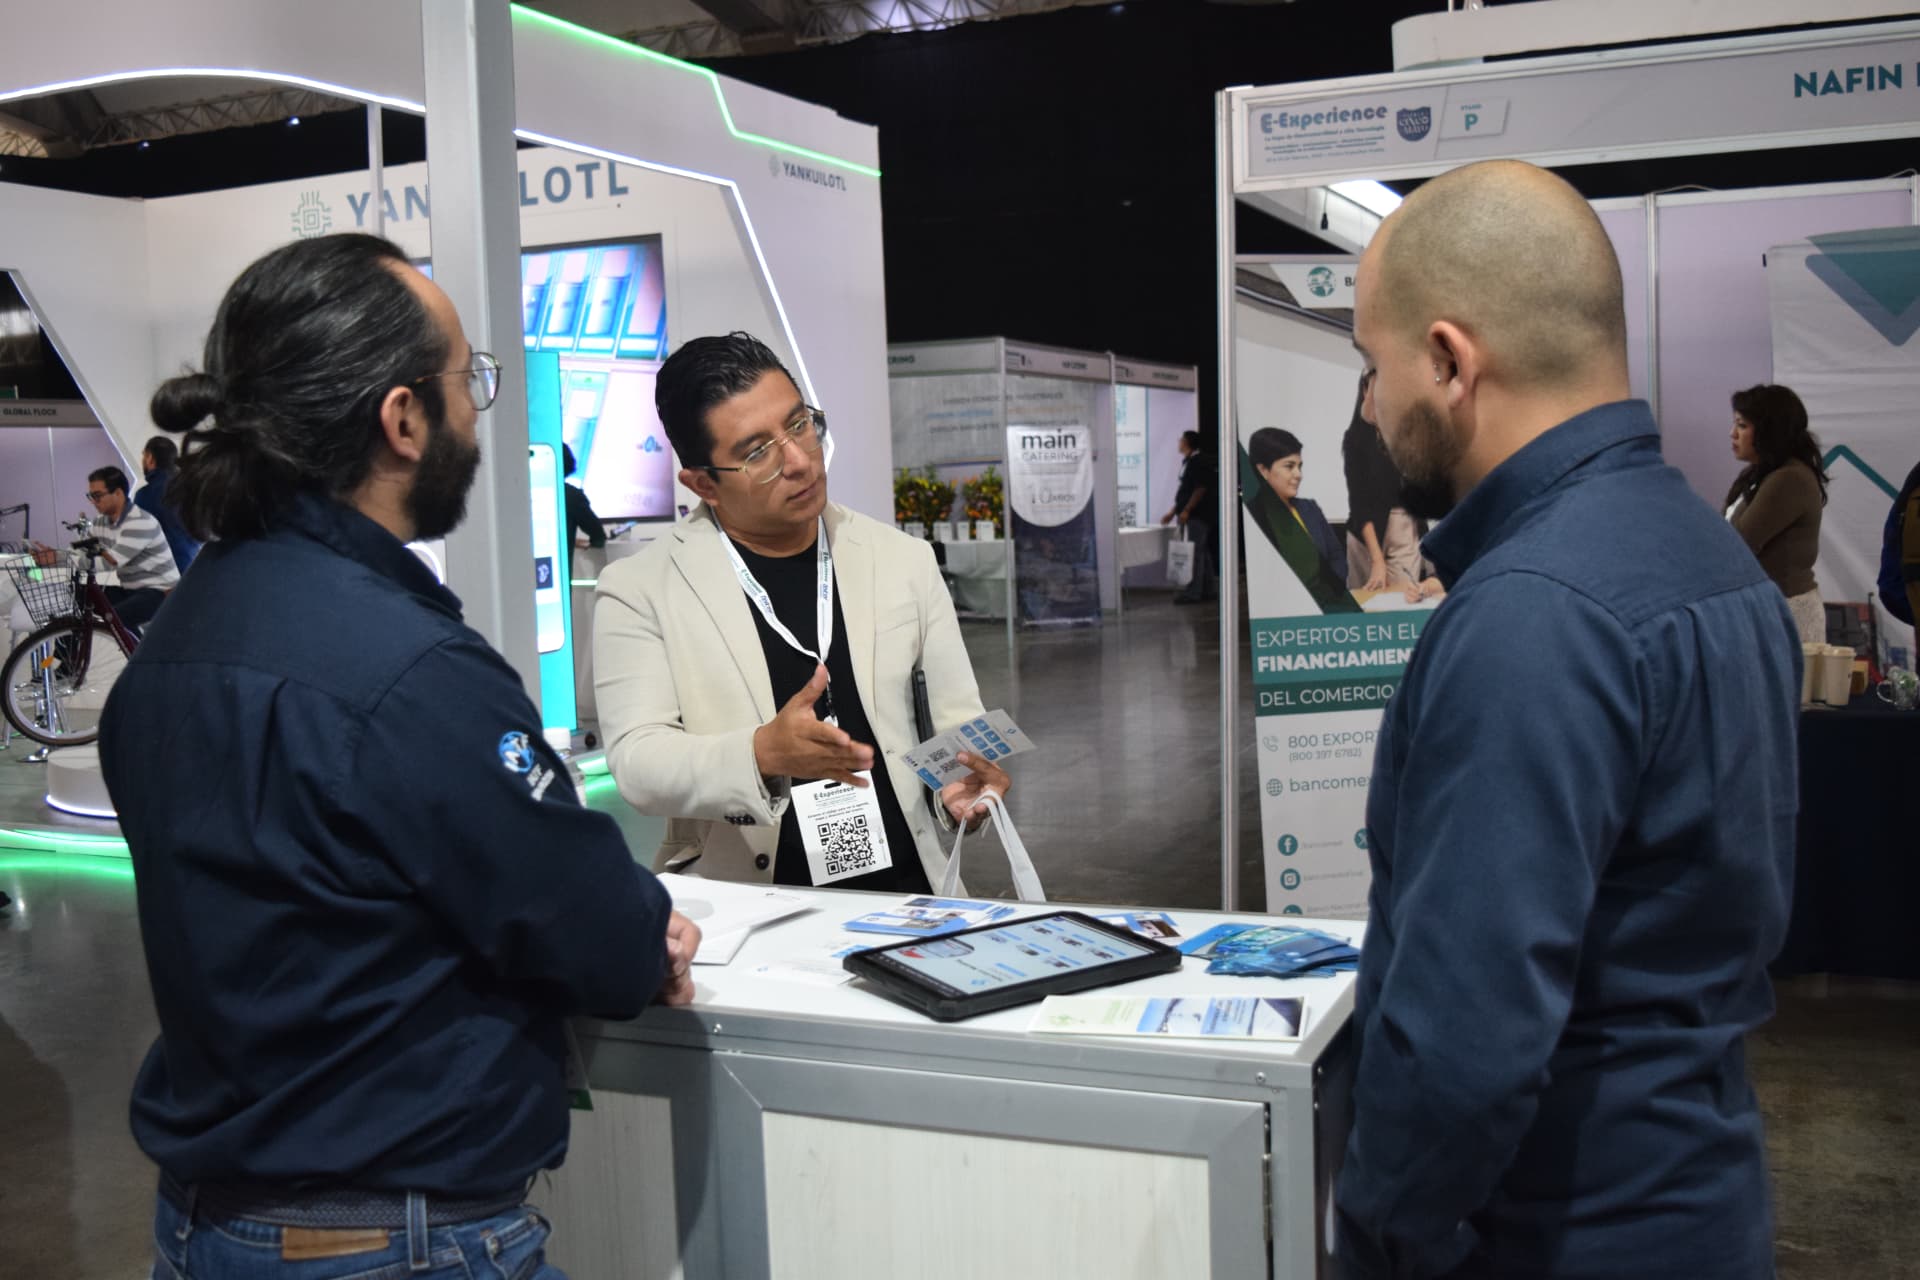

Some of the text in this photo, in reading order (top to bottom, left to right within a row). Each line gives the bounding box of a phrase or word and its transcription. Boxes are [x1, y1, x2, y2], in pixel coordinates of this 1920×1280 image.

[1794, 63, 1902, 98] NAFIN
[1261, 105, 1387, 134] E-Experience
[1465, 113, 1479, 131] P
[782, 161, 846, 191] YANKUILOTL
[346, 160, 629, 227] YANLOTL
[1022, 428, 1076, 449] main
[1022, 451, 1079, 461] CATERING
[1256, 623, 1419, 648] EXPERTOS EN EL
[1259, 684, 1395, 707] DEL COMERCIO
[1288, 735, 1318, 748] 800
[1289, 751, 1312, 764] (800
